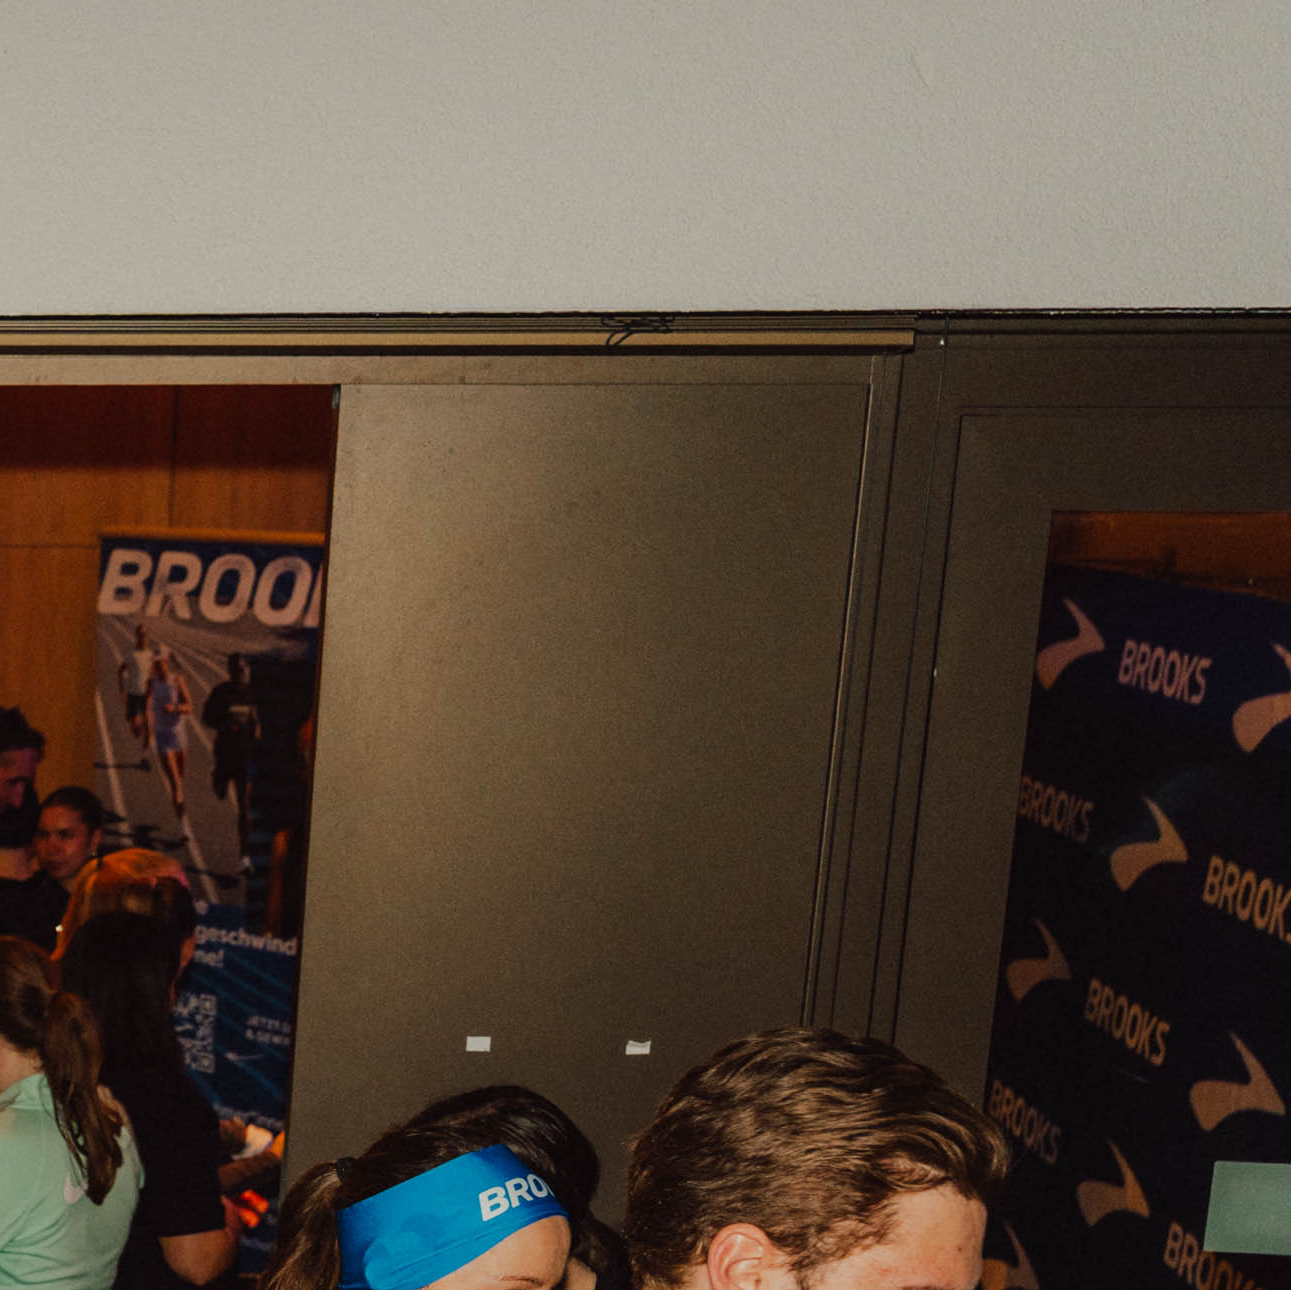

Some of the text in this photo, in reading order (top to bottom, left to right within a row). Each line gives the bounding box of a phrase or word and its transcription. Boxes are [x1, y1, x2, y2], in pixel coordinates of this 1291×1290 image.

[97, 548, 323, 628] BROO
[1118, 637, 1213, 706] BROOKS
[1019, 775, 1096, 845] BROOKS
[1202, 854, 1291, 946] BROOK
[1085, 976, 1171, 1067] BROOKS
[987, 1078, 1064, 1167] BROOKS
[479, 1174, 555, 1222] BRO
